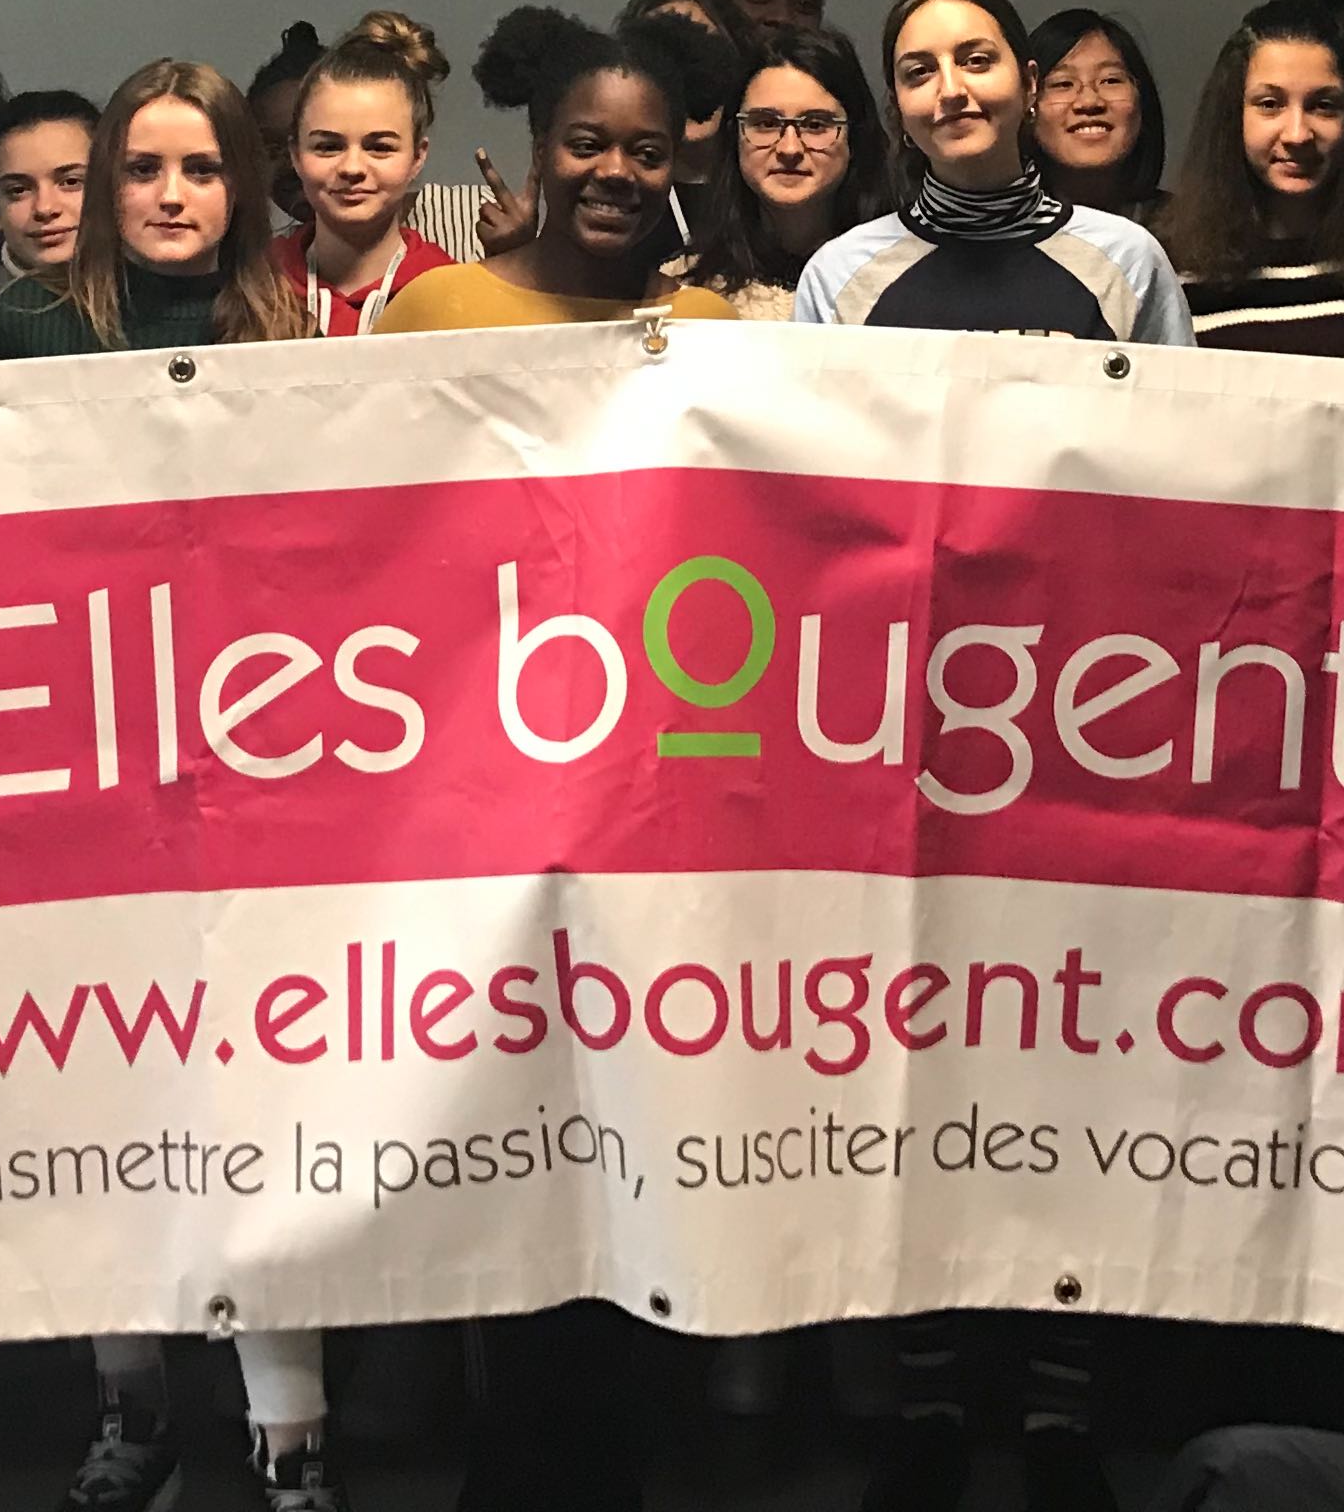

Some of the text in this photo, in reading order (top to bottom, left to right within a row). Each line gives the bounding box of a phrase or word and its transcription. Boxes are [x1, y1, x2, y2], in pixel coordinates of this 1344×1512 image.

[295, 1121, 343, 1195] la
[373, 1104, 645, 1211] passion,
[675, 1106, 917, 1190] susciter
[932, 1101, 1059, 1175] des
